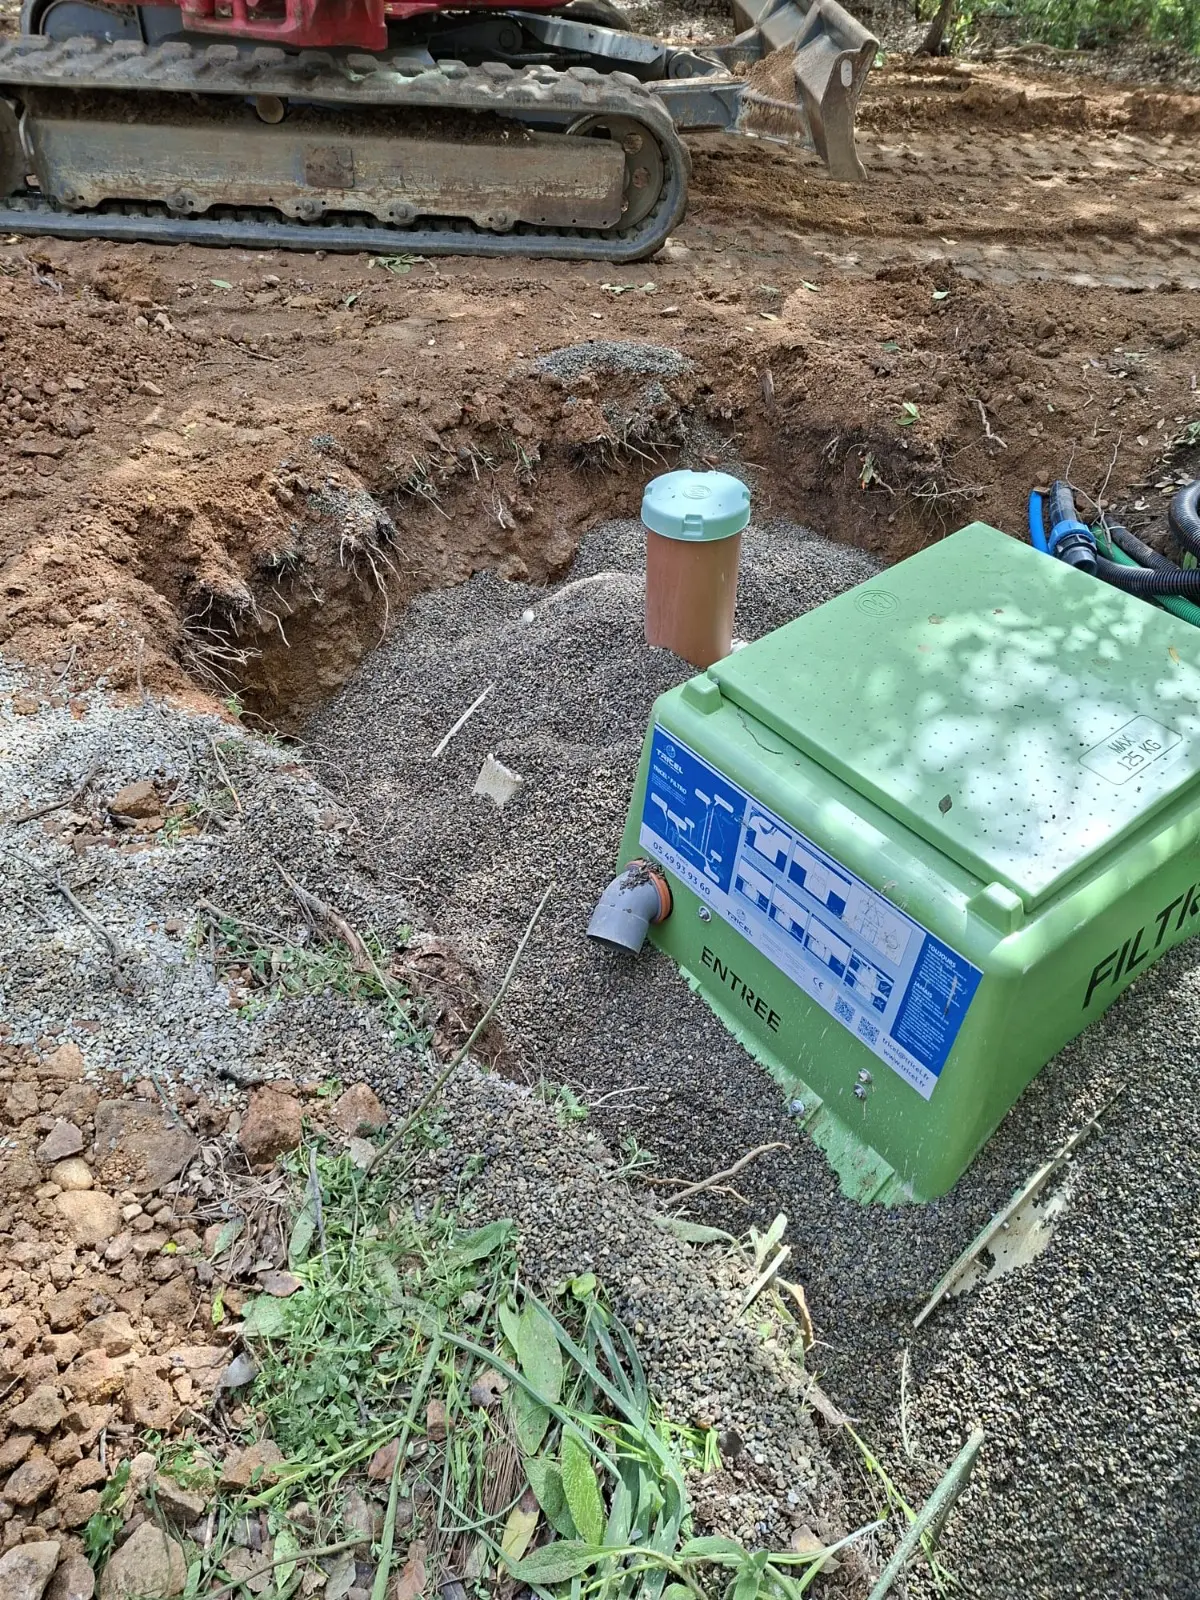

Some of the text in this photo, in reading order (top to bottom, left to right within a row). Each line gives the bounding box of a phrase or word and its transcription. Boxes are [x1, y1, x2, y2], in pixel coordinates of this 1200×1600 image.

[1107, 734, 1136, 754] MAX
[1117, 739, 1162, 771] 125 KG
[656, 748, 684, 775] TRICEL
[669, 777, 687, 795] FILTRO
[653, 841, 711, 895] 05 49 93 93 60
[726, 909, 753, 937] TRICEL
[928, 943, 956, 968] TOUJOURS
[701, 945, 782, 1033] ENTREE
[913, 980, 933, 999] JAMAIS
[882, 1037, 930, 1081] tricel@tricel.fr
[883, 1049, 926, 1088] www.tricel.fr
